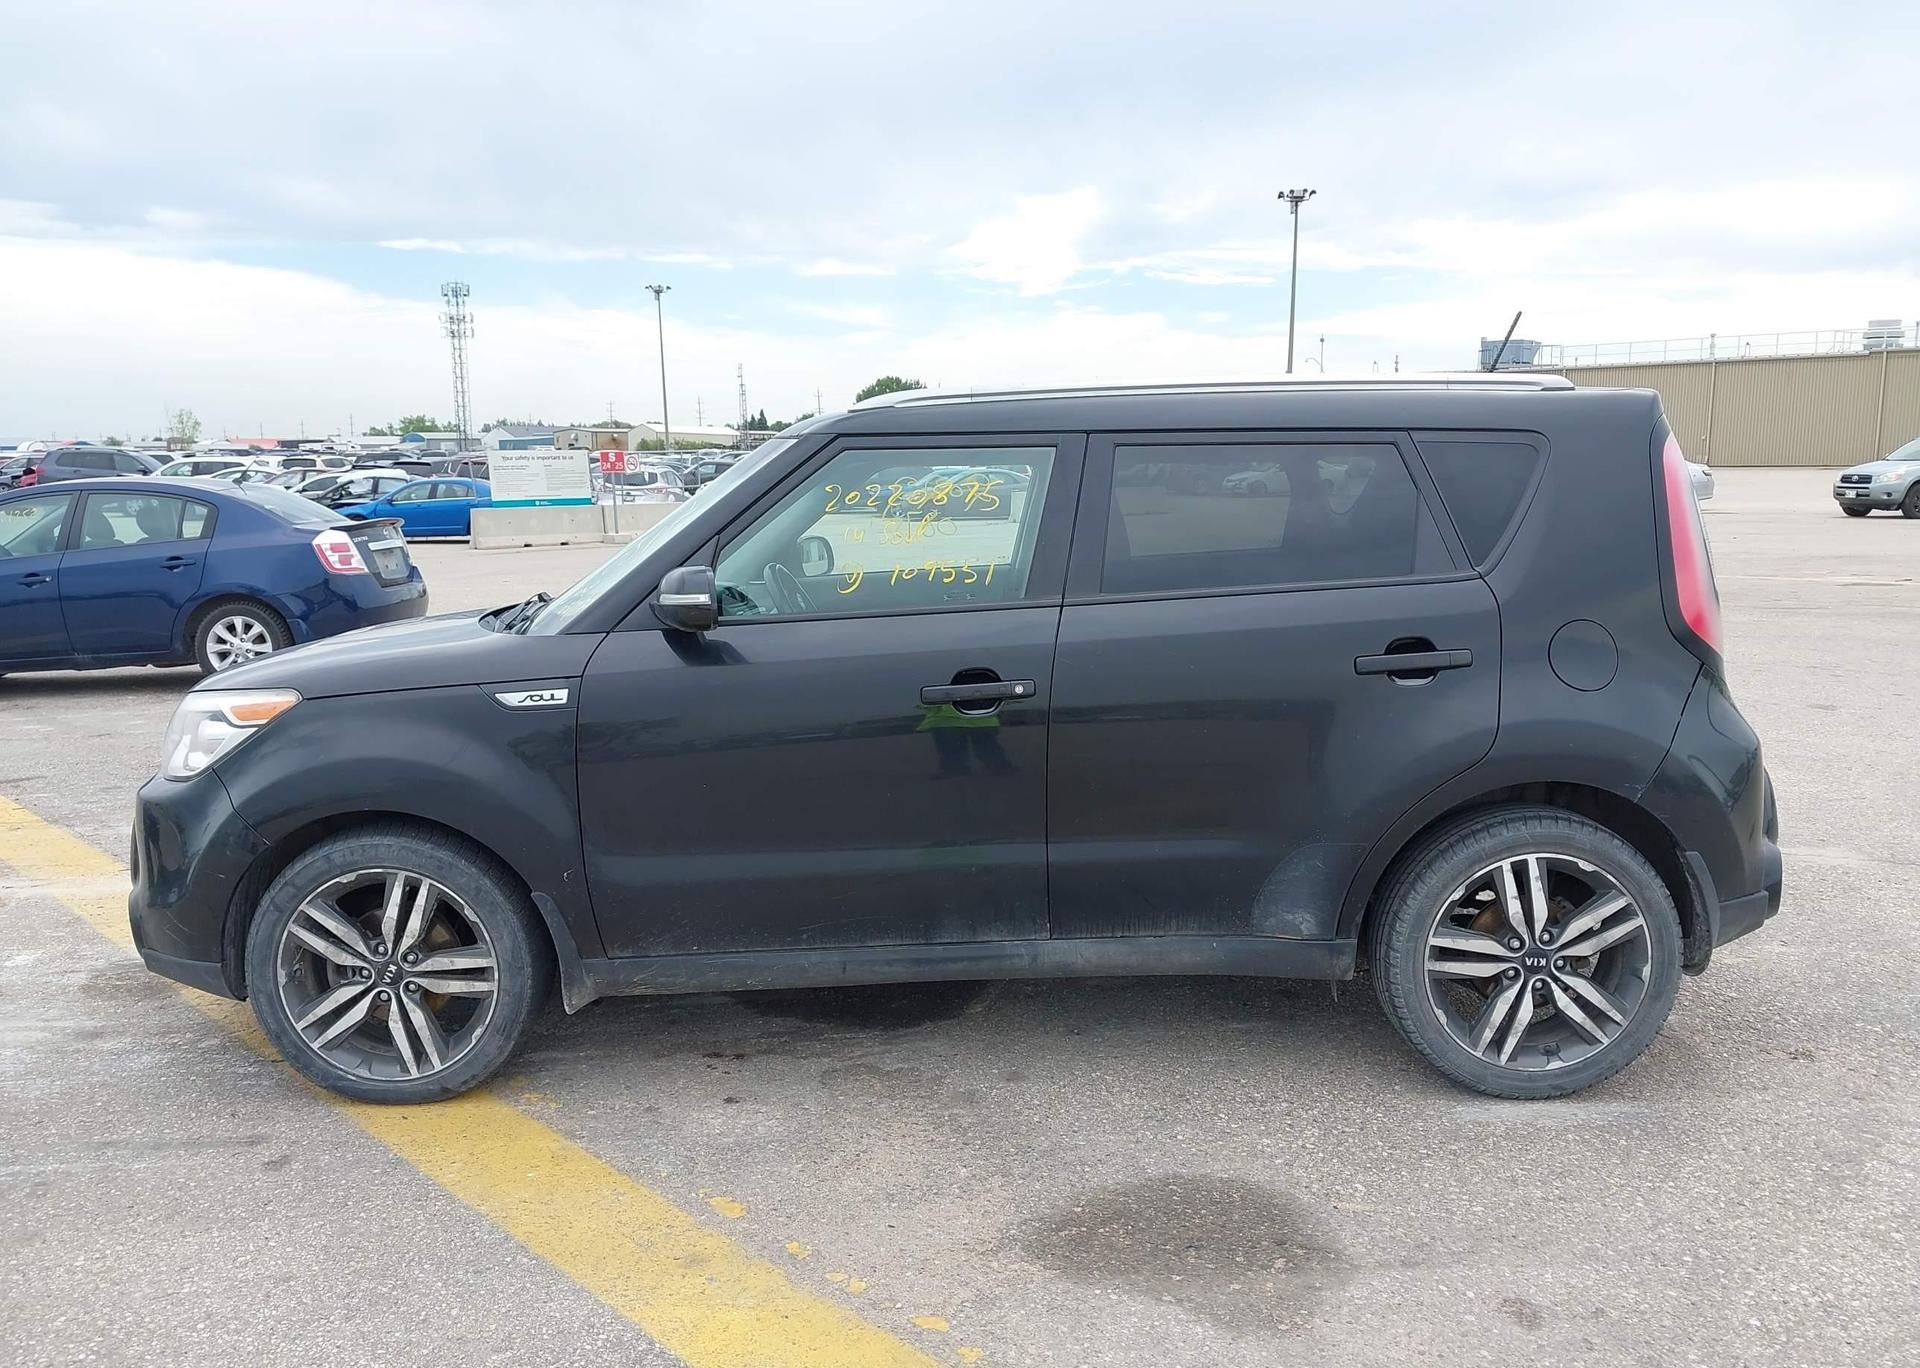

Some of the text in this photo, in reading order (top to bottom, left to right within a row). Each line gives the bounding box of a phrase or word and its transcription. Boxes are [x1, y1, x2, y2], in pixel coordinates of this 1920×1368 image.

[608, 452, 616, 463] S
[602, 462, 624, 470] 24 25
[517, 693, 563, 704] SOUL
[1525, 957, 1547, 967] KIA
[381, 963, 398, 983] KIA
